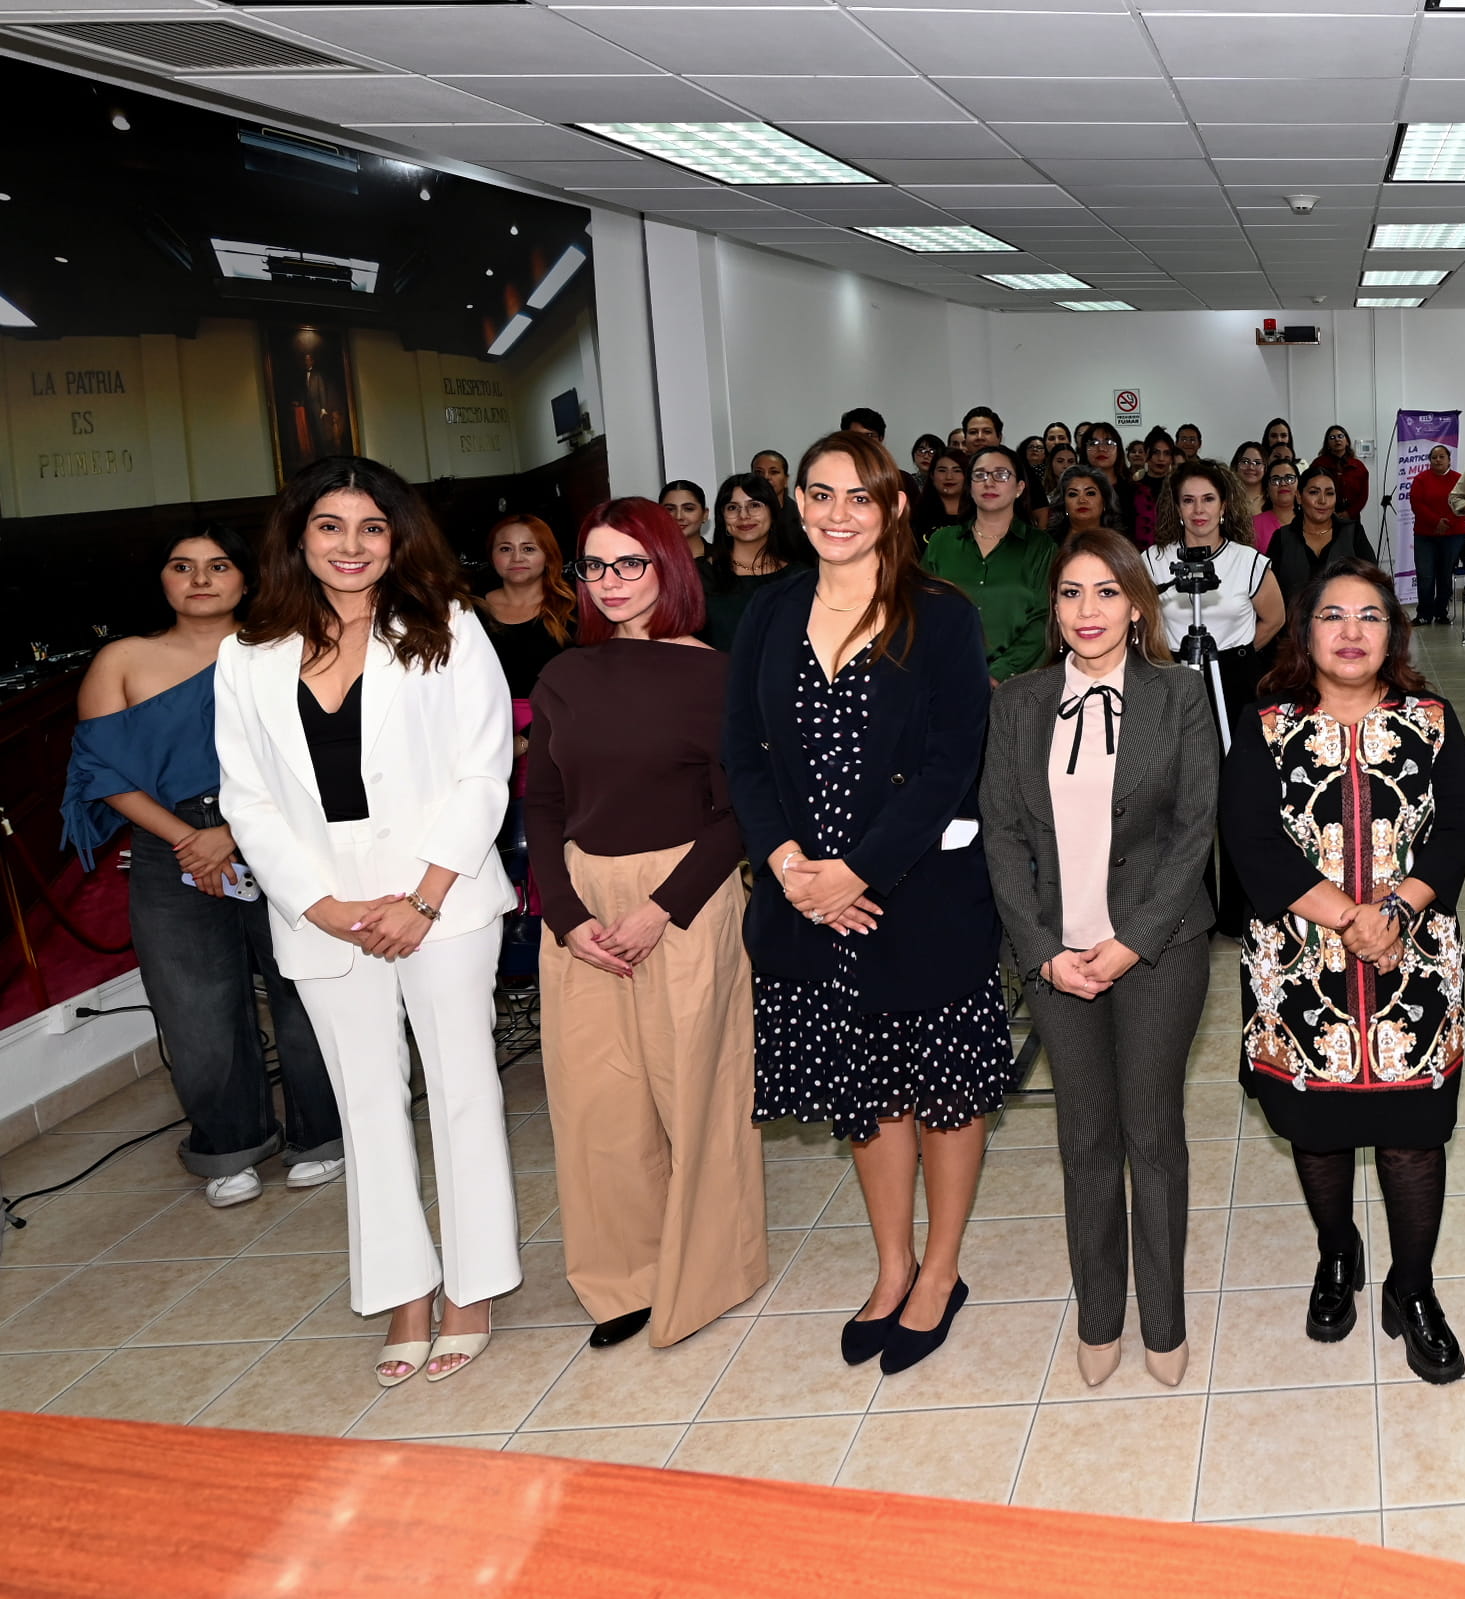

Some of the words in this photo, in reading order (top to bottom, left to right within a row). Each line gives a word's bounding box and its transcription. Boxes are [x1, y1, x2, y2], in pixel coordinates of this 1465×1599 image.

[31, 371, 56, 396] LA
[65, 369, 126, 395] PATRIA
[443, 378, 456, 395] EL
[456, 379, 491, 397] RESPETO
[71, 411, 94, 435] ES
[1408, 445, 1418, 453] LA
[38, 449, 133, 479] PRIMERO
